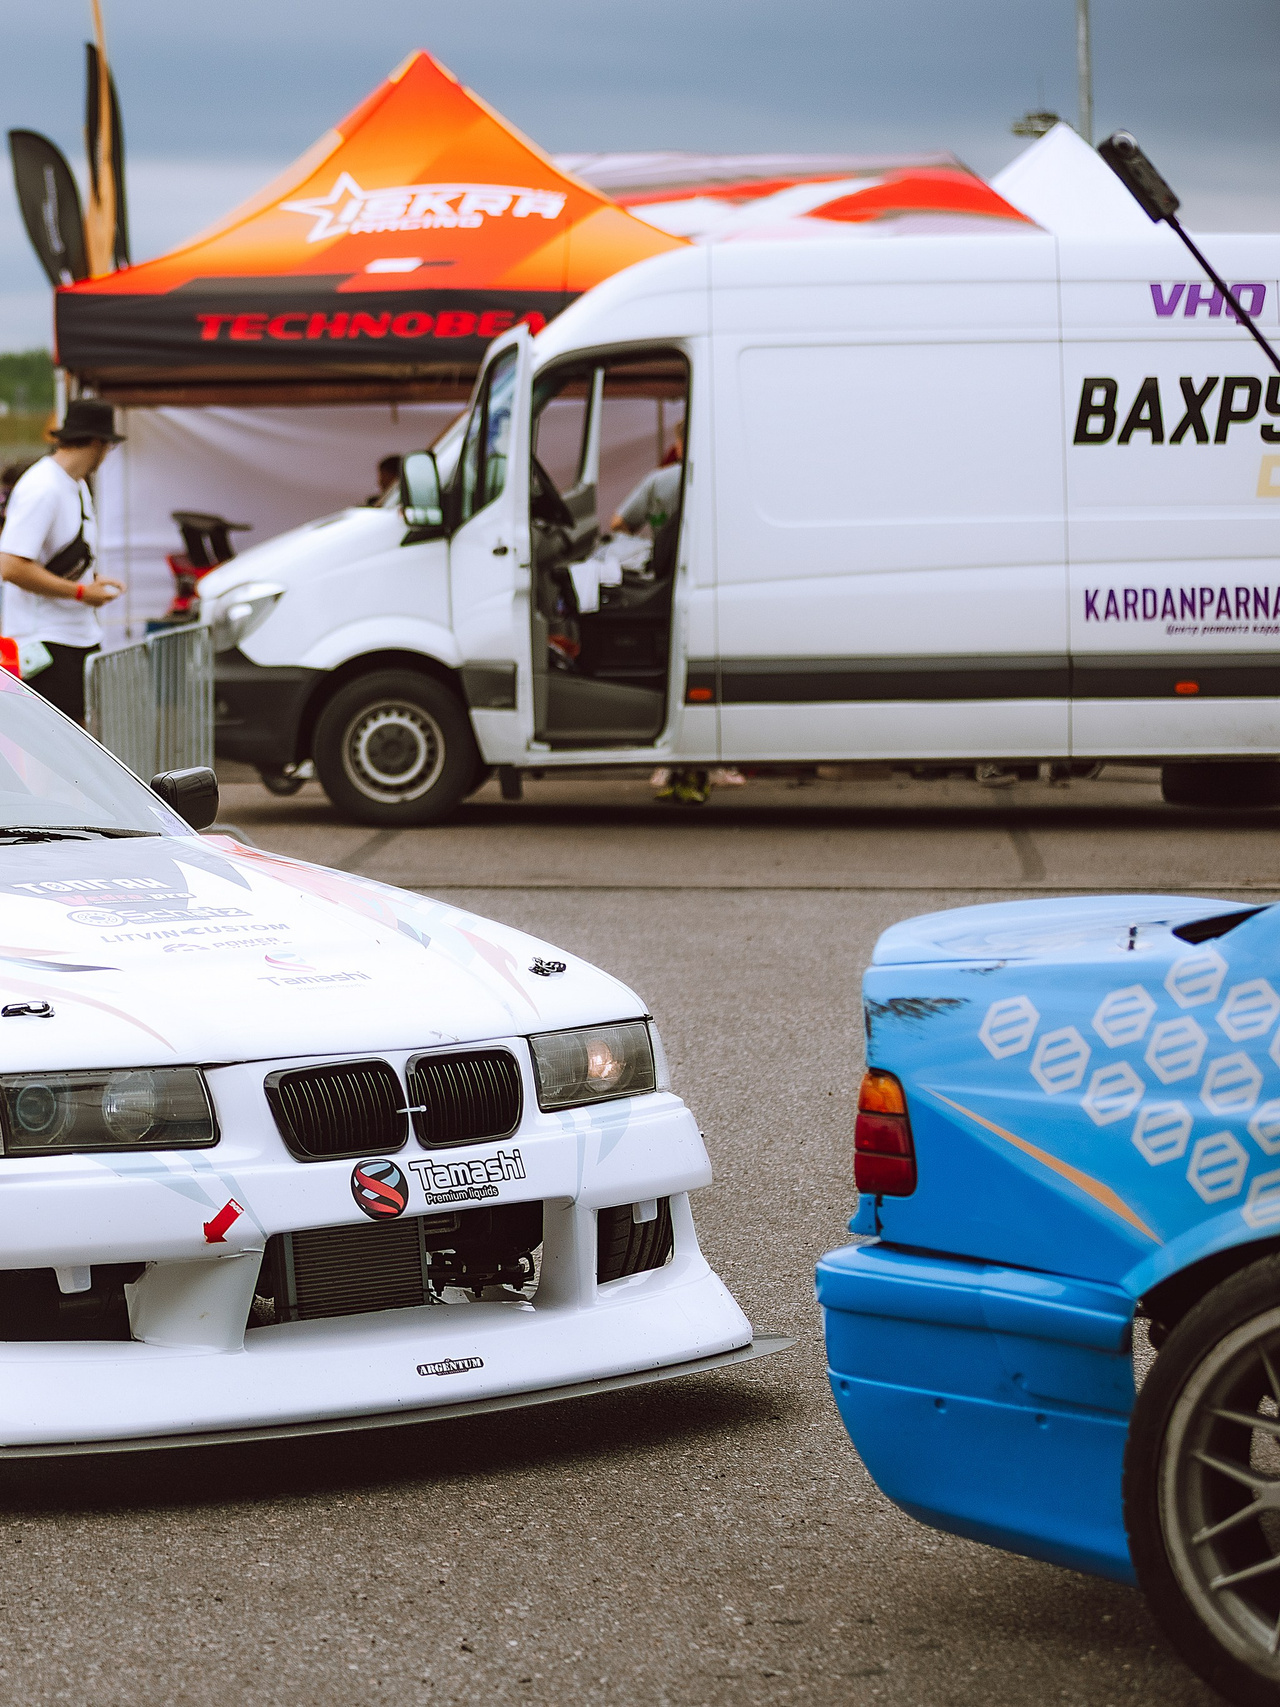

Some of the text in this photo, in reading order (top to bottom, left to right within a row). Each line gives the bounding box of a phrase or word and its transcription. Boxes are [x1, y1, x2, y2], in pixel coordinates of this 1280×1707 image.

[116, 906, 253, 921] Schatz
[257, 971, 372, 986] Tamashi
[411, 1151, 525, 1189] Tamashi
[426, 1186, 499, 1204] Premium liquids
[420, 1358, 481, 1375] ARGENTUM
